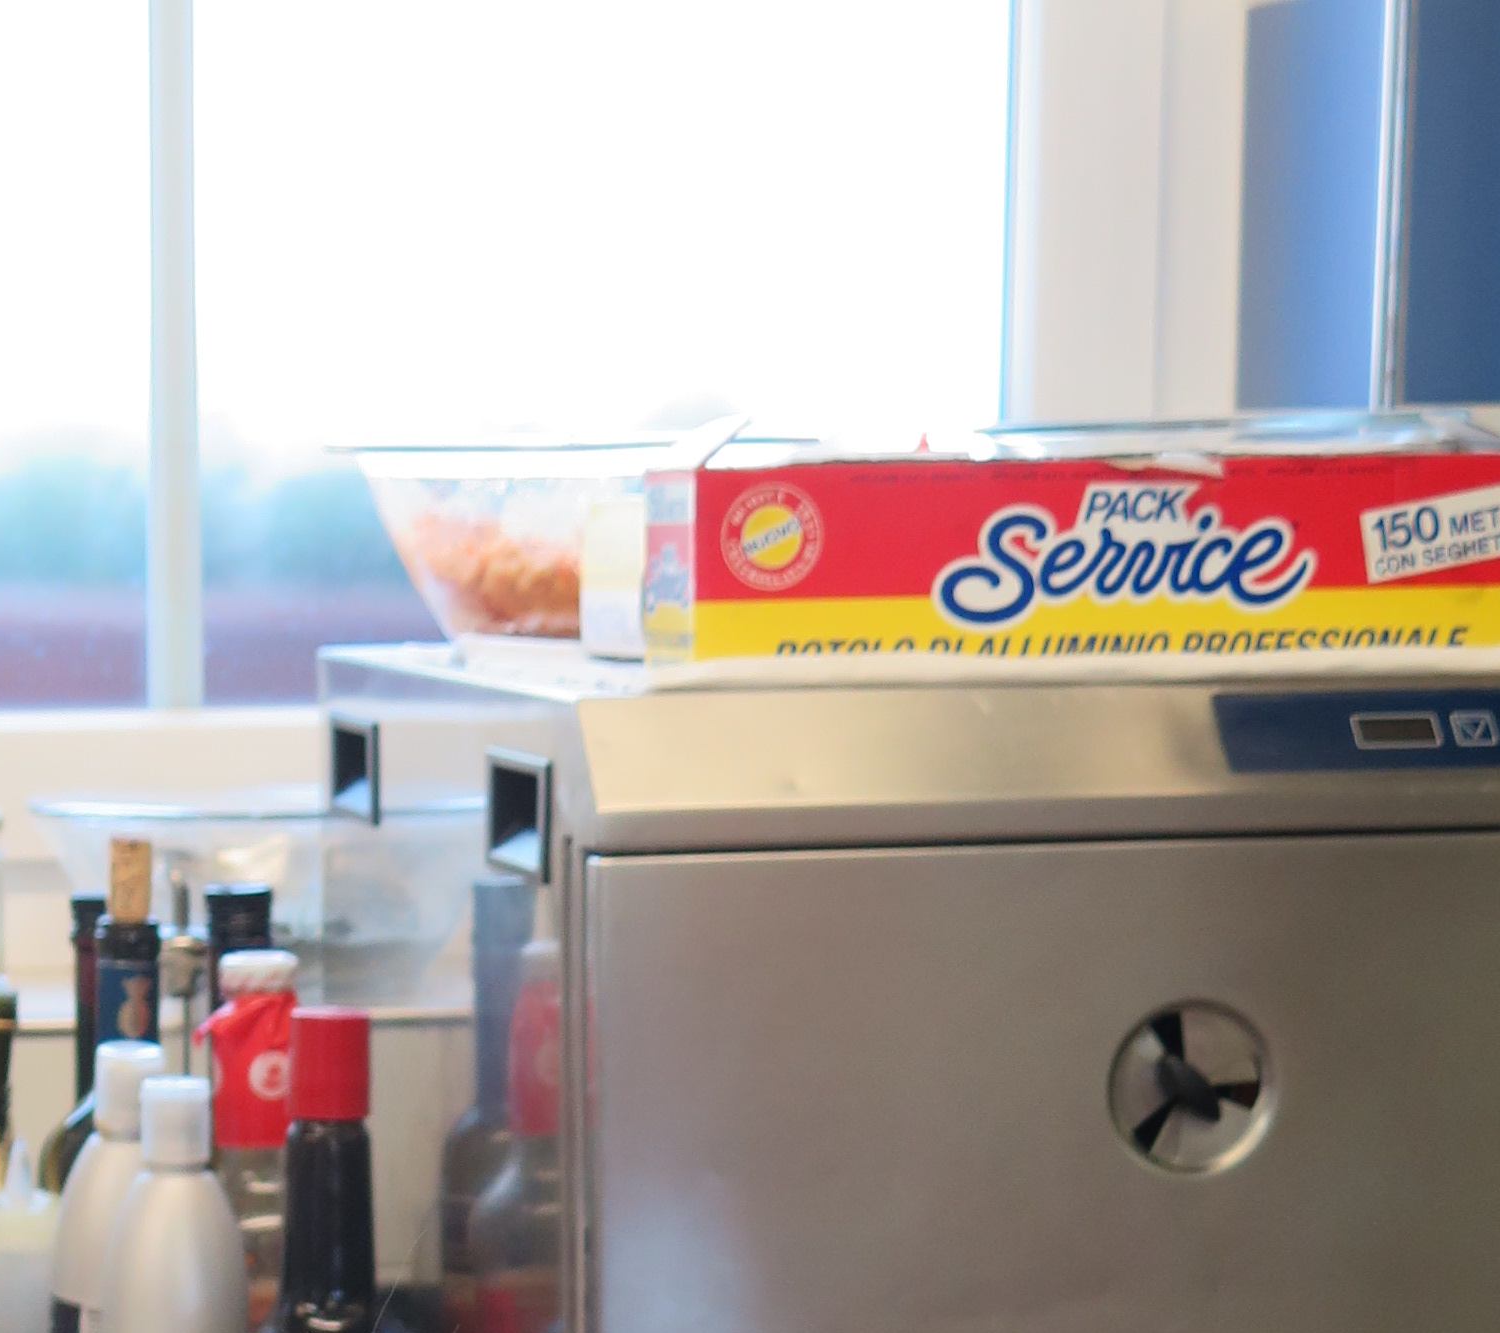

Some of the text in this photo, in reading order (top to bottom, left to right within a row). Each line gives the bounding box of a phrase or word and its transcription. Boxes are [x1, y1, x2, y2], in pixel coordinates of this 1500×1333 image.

[1084, 488, 1187, 523] PACK
[1372, 506, 1441, 551] 150
[940, 510, 1308, 624] Service
[1375, 553, 1416, 577] CON
